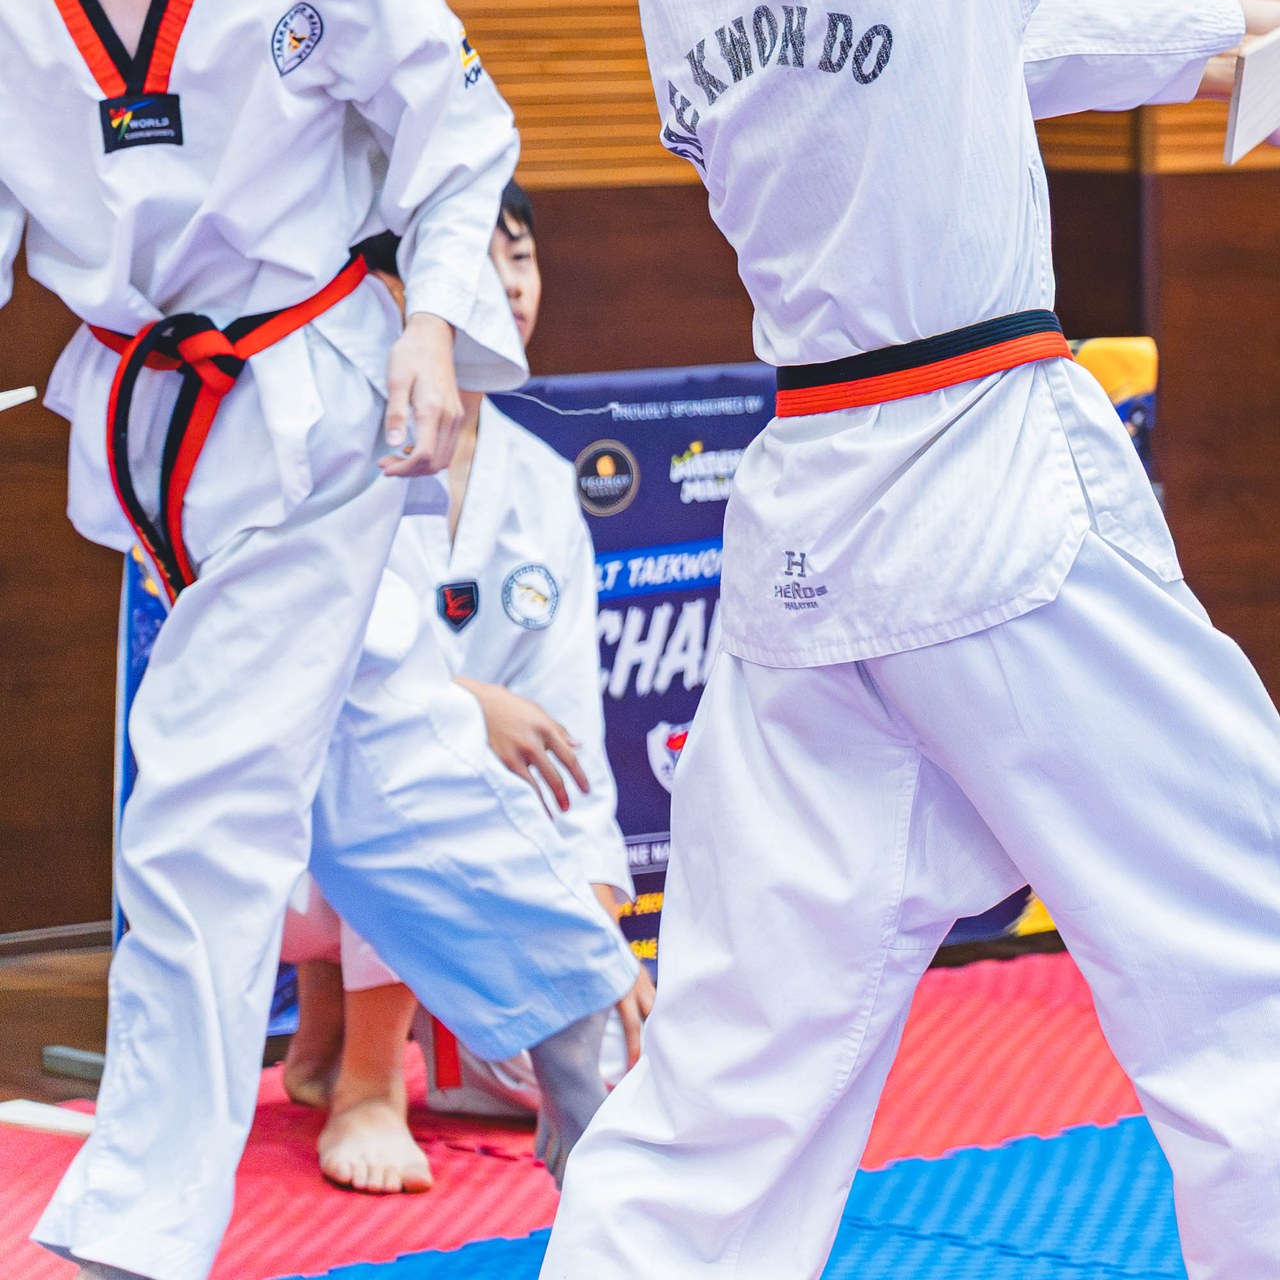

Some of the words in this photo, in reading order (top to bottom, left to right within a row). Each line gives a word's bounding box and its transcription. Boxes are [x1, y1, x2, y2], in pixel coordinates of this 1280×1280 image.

[817, 11, 893, 86] DO
[129, 117, 169, 129] WORLD
[627, 548, 722, 588] TAEKWO
[784, 550, 806, 578] H
